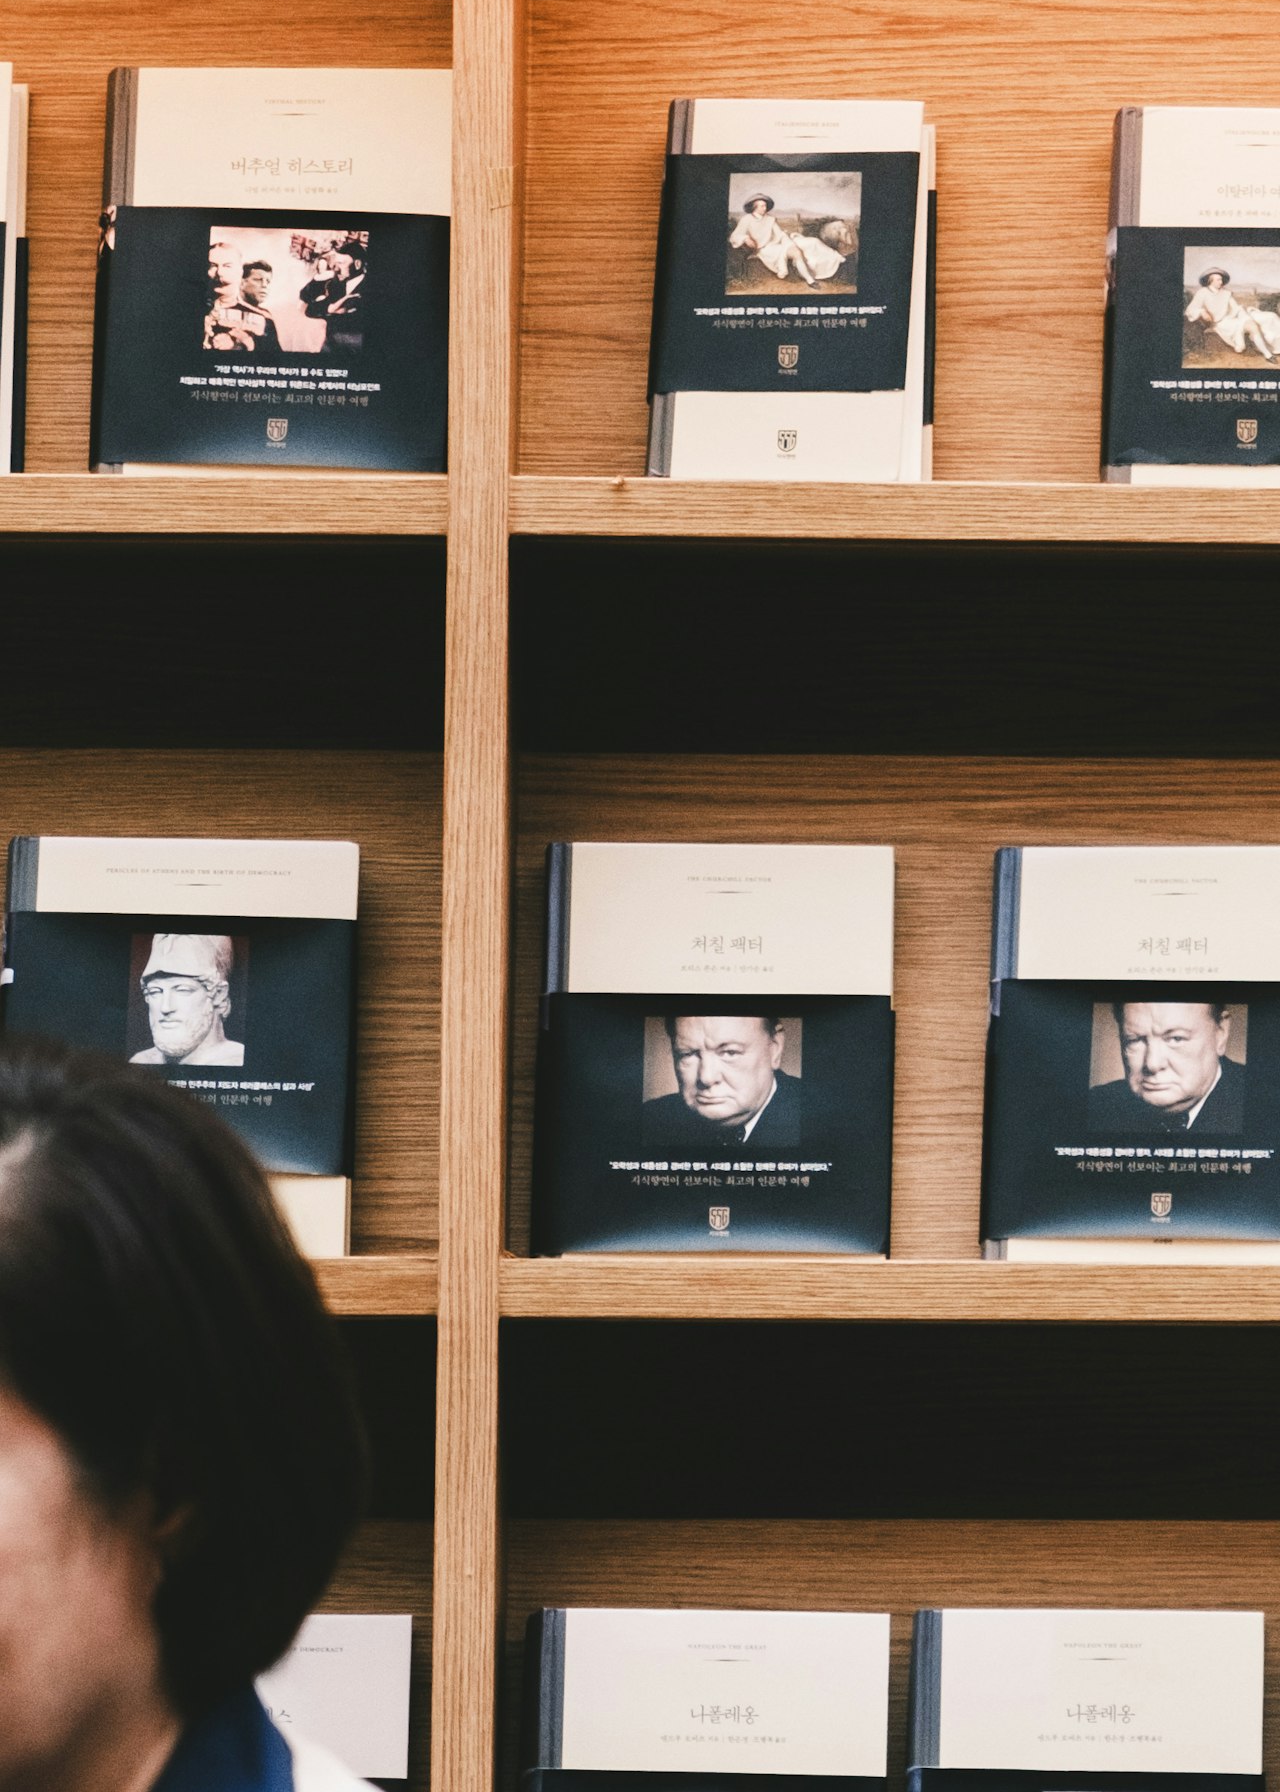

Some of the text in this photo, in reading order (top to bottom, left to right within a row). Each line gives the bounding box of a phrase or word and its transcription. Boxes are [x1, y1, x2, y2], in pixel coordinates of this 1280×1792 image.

[230, 156, 354, 176] 버추얼 히스토리
[1216, 183, 1267, 199] 이탈리아
[692, 934, 763, 955] 처칠 팩터
[1138, 936, 1209, 956] 처칠 팩터
[689, 1704, 760, 1726] 나폴레옹
[1066, 1703, 1136, 1725] 나폴레옹
